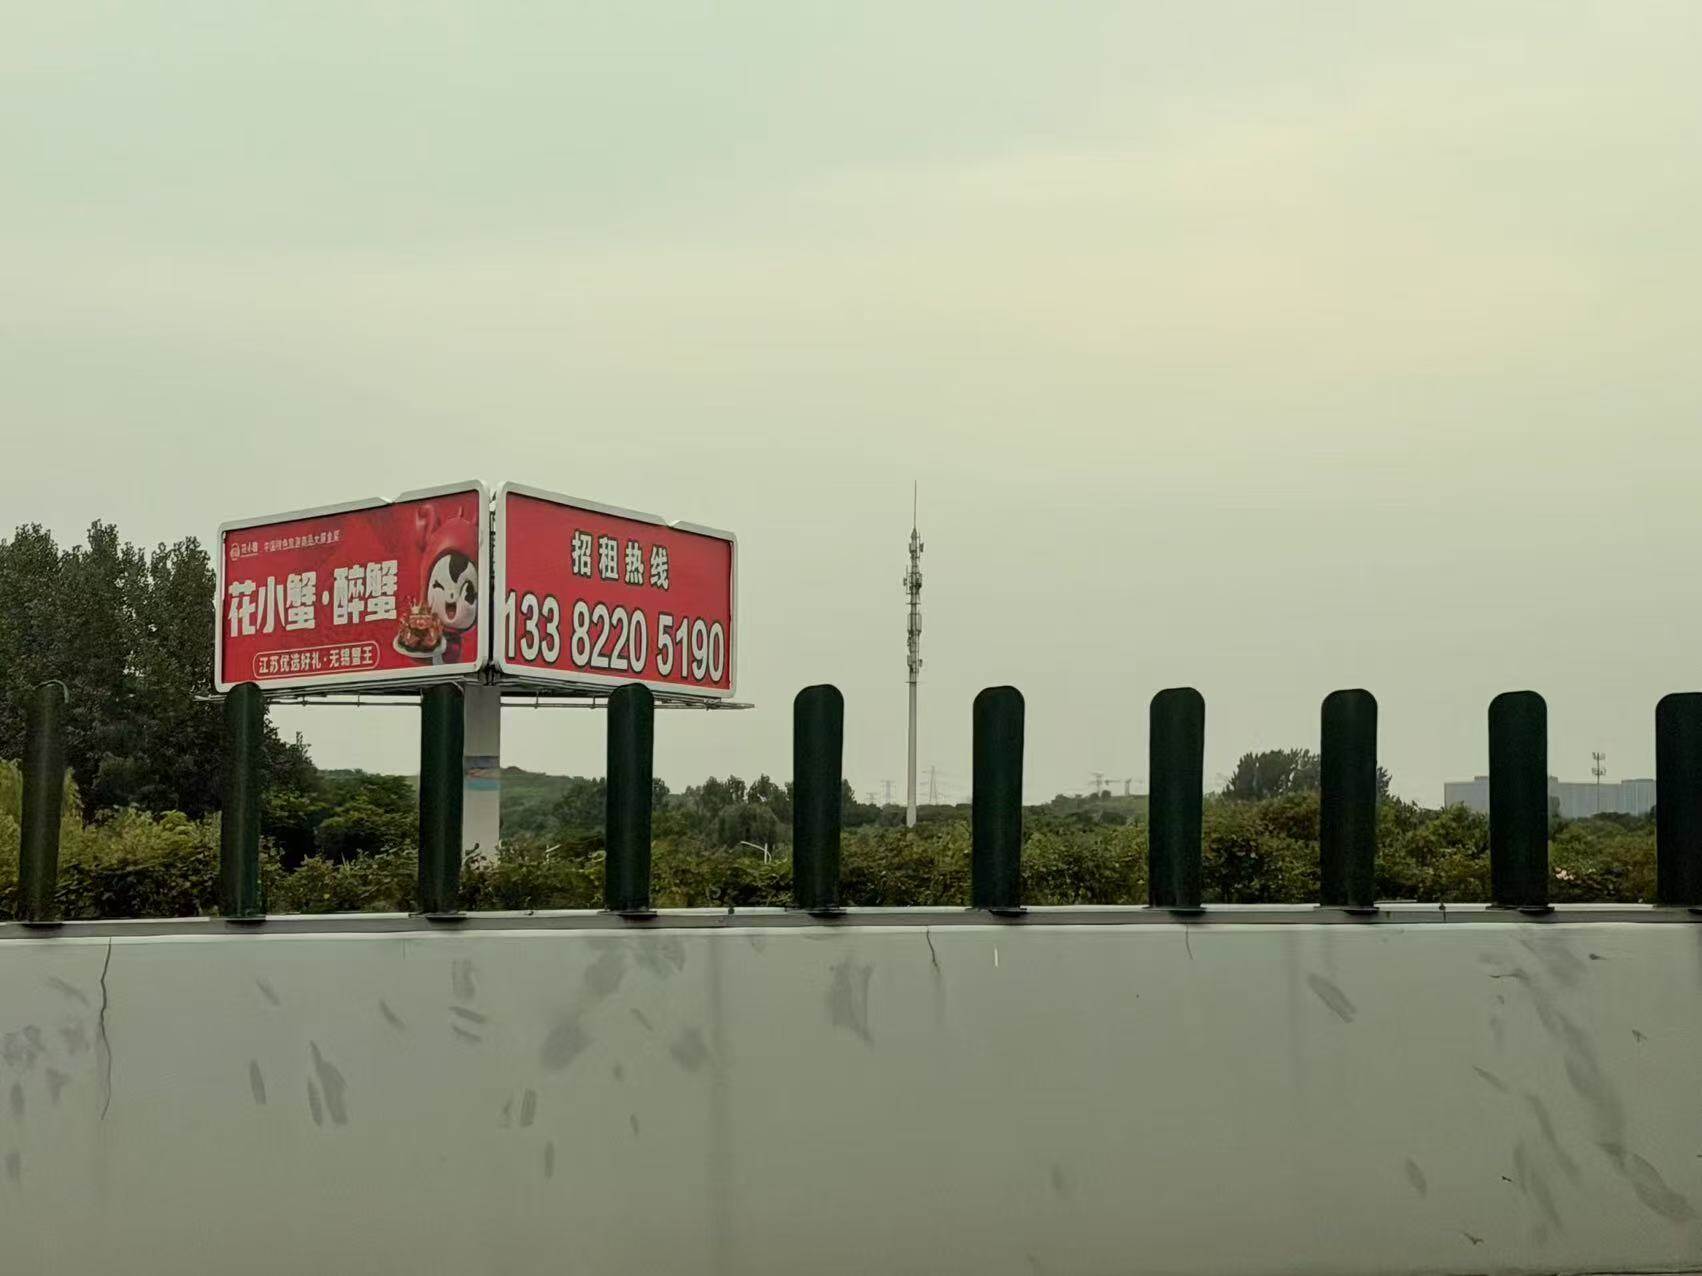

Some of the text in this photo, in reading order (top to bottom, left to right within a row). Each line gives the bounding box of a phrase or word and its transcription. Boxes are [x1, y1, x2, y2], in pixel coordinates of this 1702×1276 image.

[572, 531, 669, 589] 招租热线
[504, 591, 725, 682] 133 8220 5190
